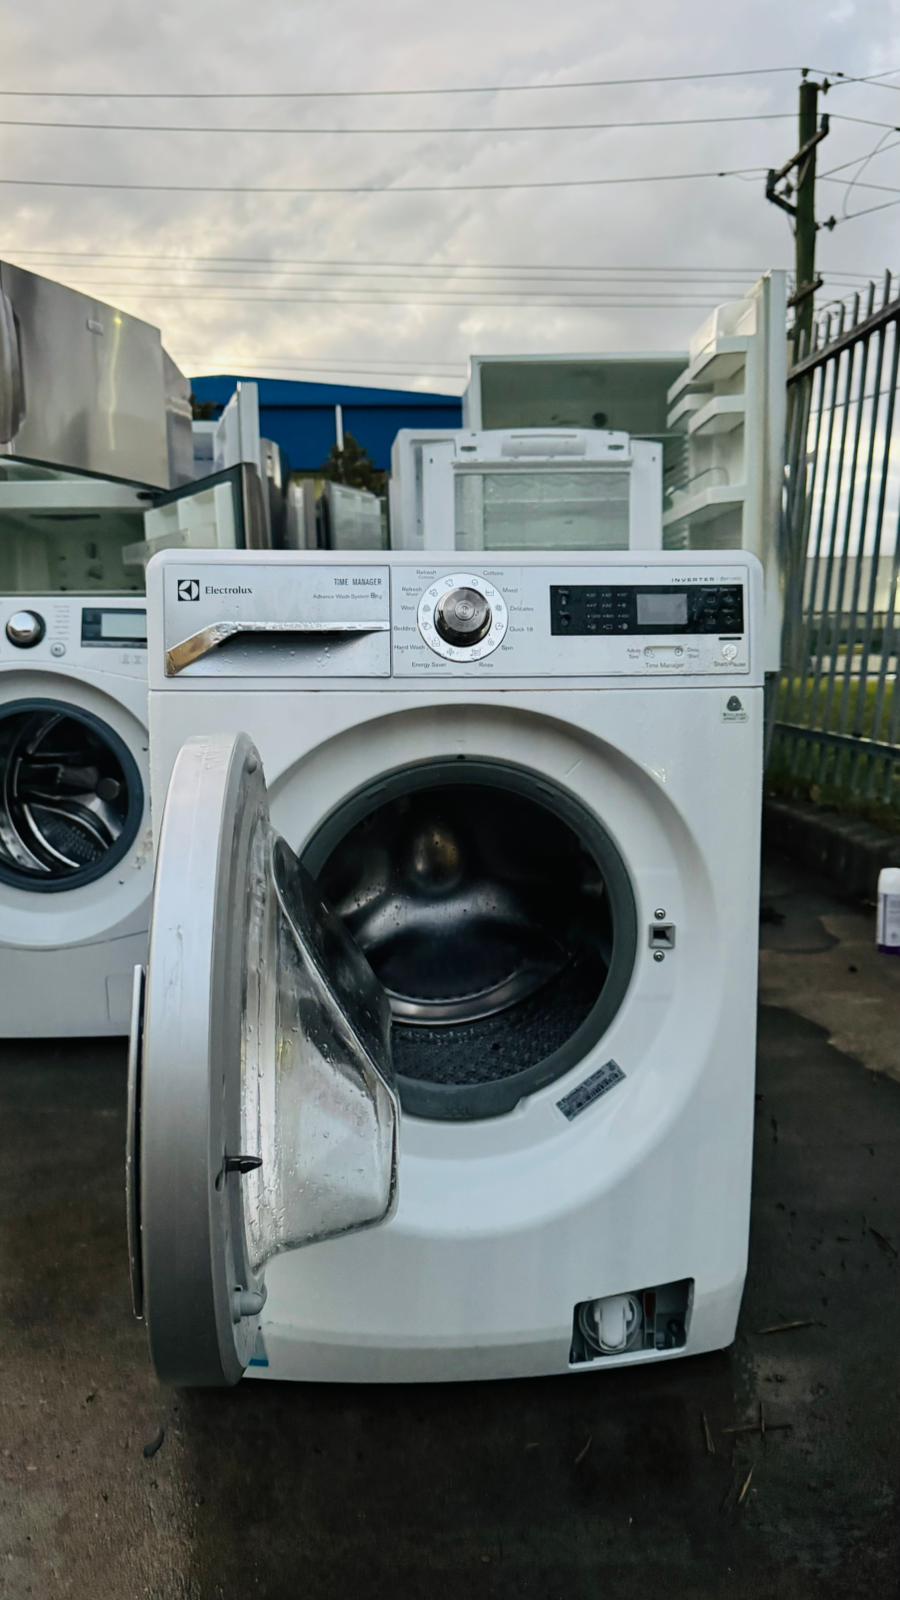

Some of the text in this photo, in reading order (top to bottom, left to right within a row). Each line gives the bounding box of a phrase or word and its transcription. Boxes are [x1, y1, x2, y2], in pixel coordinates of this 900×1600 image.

[334, 578, 382, 586] TIME MANAGER
[205, 586, 253, 595] Electrolux
[411, 661, 431, 669] Energy
